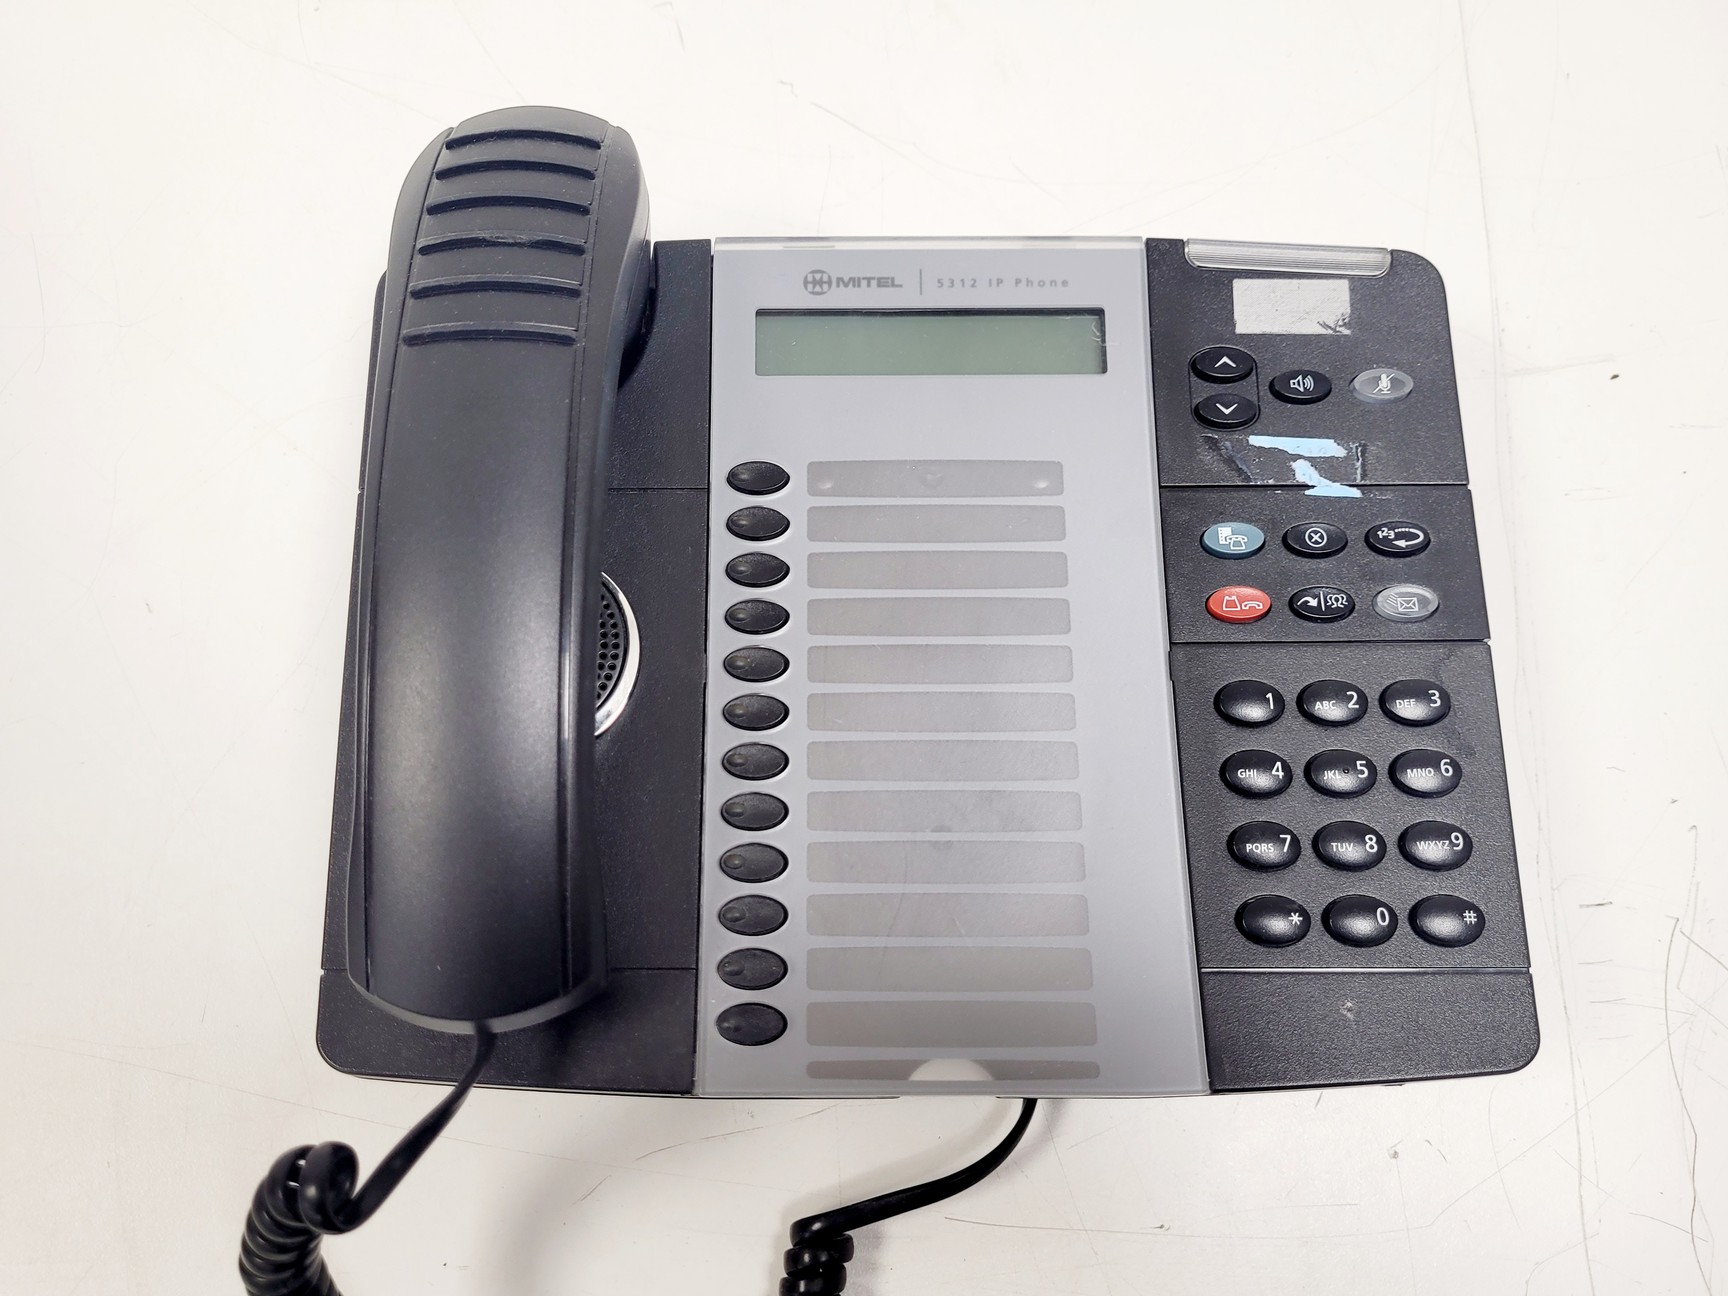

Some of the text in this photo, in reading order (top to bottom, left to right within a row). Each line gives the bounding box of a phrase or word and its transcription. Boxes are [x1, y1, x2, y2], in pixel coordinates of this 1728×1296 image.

[835, 276, 903, 288] MITEL
[936, 278, 1070, 289] 5312 IP Phone
[1265, 692, 1274, 710] 1
[1315, 691, 1359, 710] ABC 2
[1396, 690, 1441, 709] DEF 3
[1237, 761, 1284, 779] GHI 4
[1323, 760, 1369, 780] JKL 5
[1407, 758, 1453, 778] MNO 6
[1246, 834, 1291, 854] PQRS 7
[1331, 834, 1378, 852] TUV 8
[1416, 832, 1464, 851] WXYZ 9
[1376, 907, 1390, 925] 0
